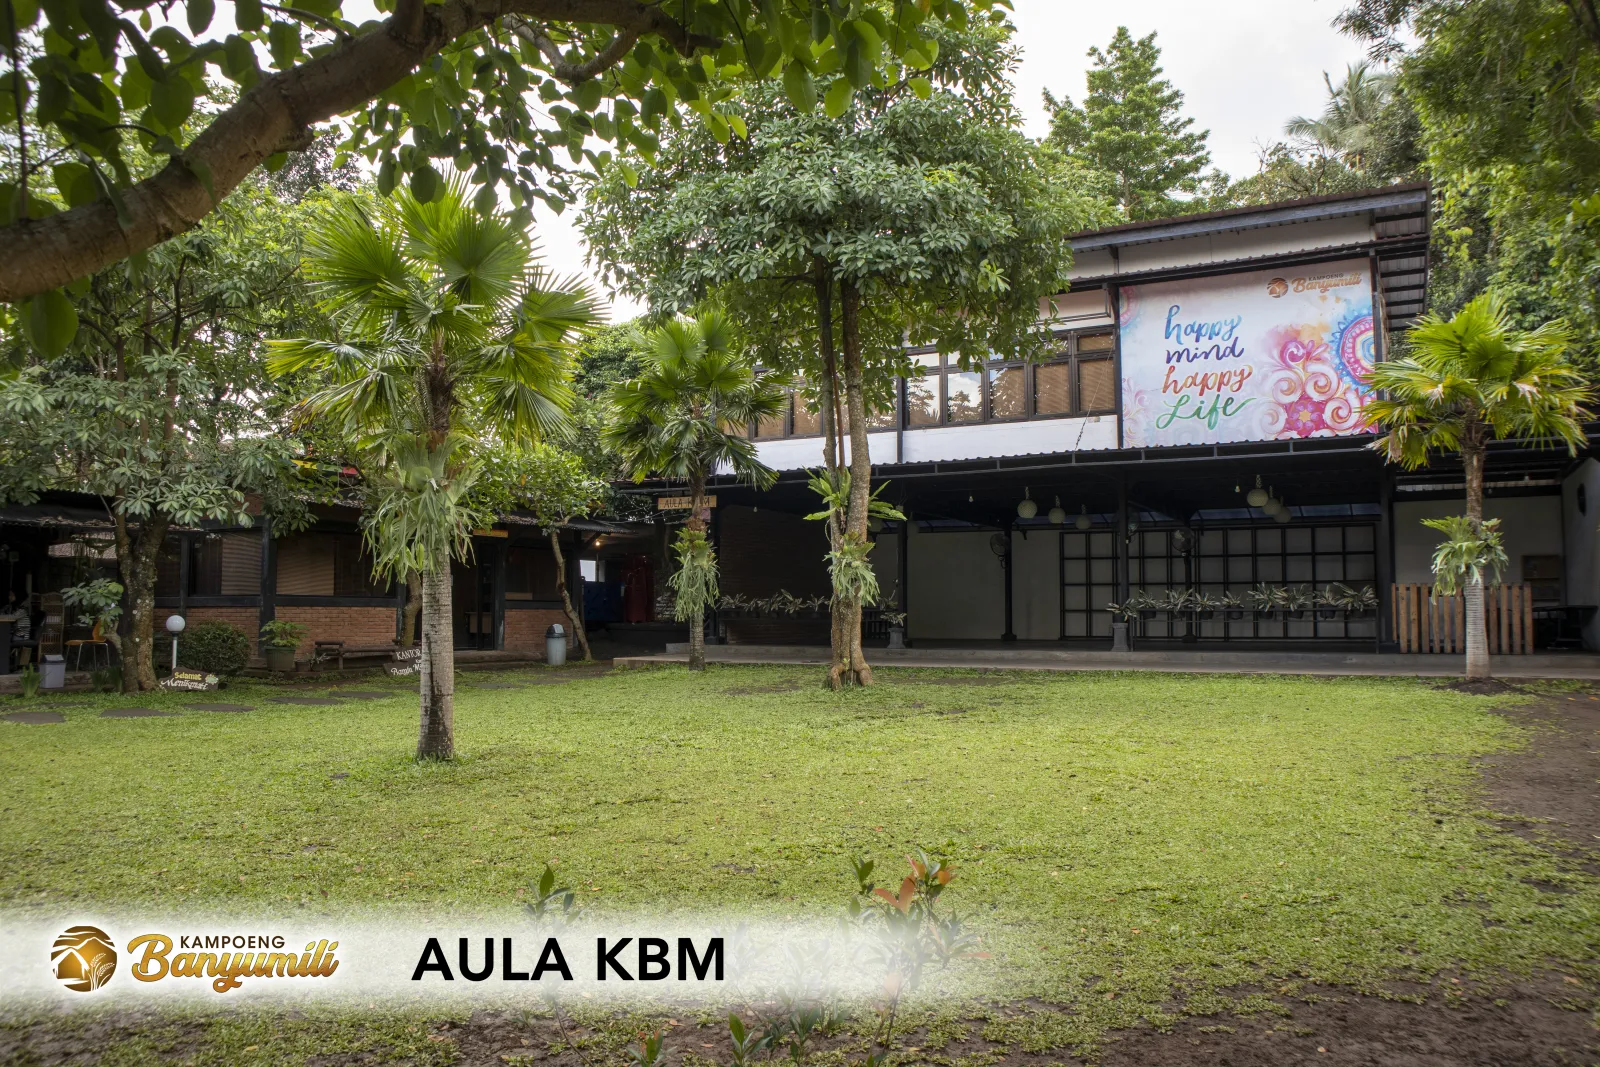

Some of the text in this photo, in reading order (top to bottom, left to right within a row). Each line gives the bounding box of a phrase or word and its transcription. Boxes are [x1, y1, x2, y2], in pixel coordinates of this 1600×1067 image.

[1164, 304, 1242, 345] happy
[1165, 336, 1244, 364] mind
[1162, 364, 1253, 397] happy
[1156, 394, 1257, 430] Life
[664, 497, 709, 508] AULA KM
